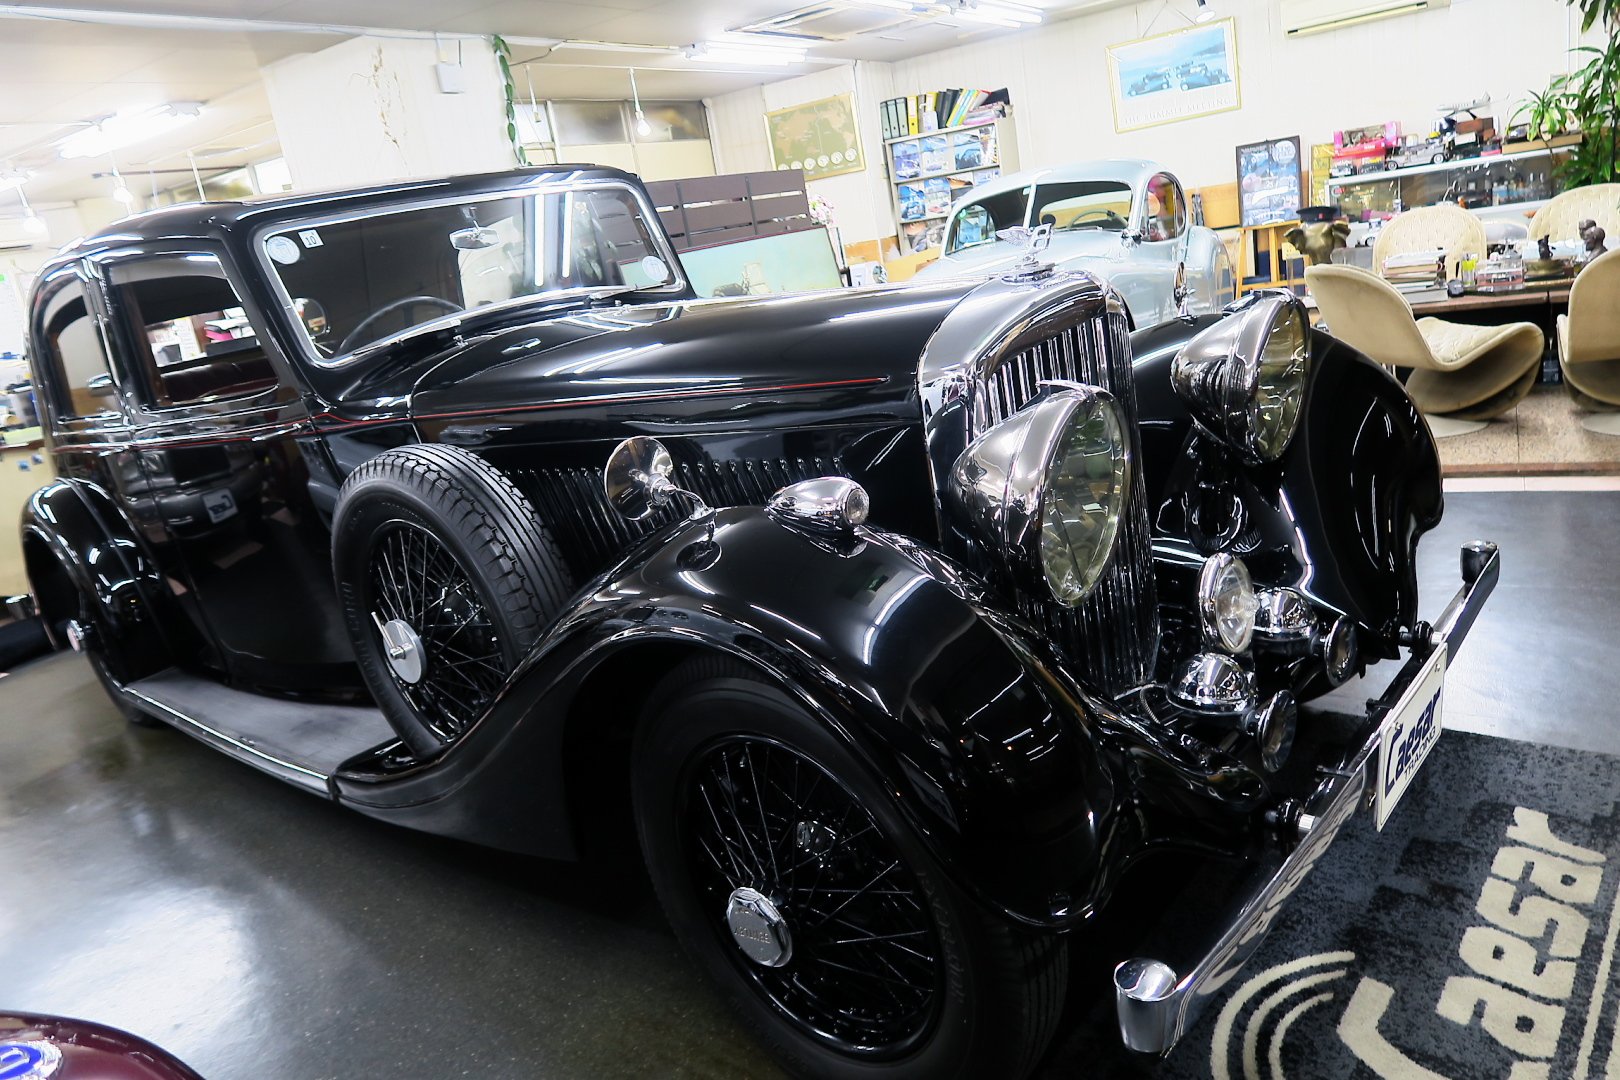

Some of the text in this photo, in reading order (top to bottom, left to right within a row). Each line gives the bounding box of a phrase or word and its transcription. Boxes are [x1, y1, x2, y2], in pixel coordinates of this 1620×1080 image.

[305, 235, 317, 246] 10
[1385, 686, 1442, 799] Caesar
[1403, 724, 1437, 781] TRADING
